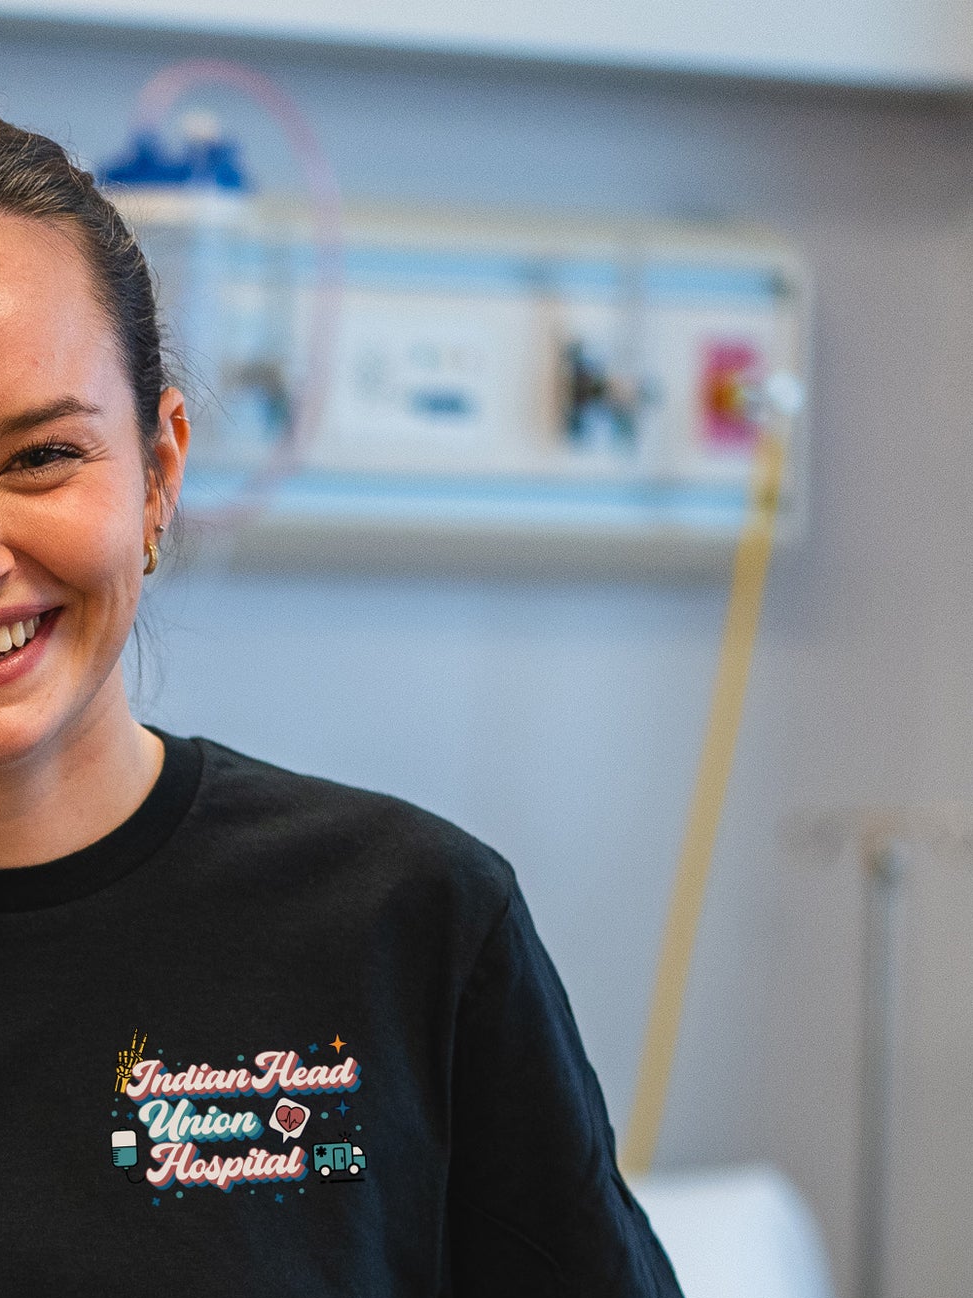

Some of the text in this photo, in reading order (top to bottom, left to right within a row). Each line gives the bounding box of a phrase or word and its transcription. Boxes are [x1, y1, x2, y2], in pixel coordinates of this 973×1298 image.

[126, 1050, 358, 1099] Indian Head
[138, 1098, 259, 1142] Union
[146, 1142, 305, 1188] Hospital
